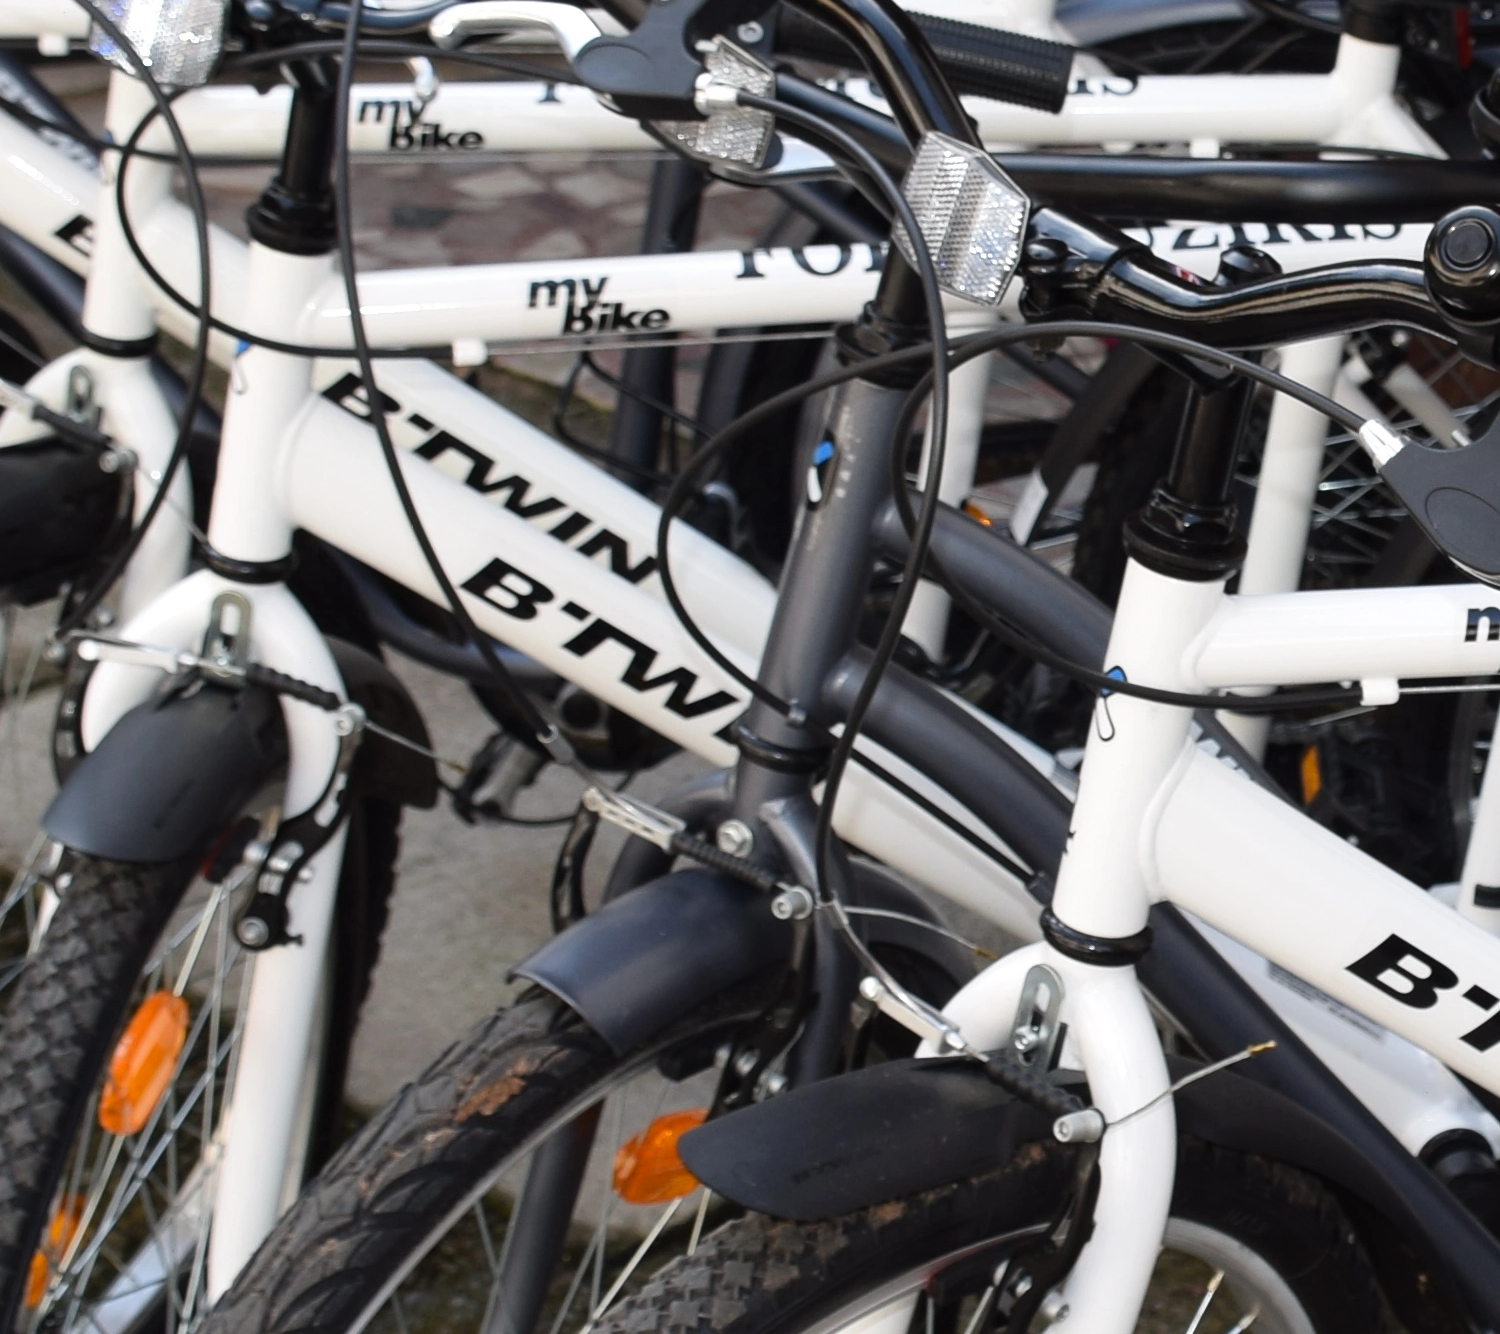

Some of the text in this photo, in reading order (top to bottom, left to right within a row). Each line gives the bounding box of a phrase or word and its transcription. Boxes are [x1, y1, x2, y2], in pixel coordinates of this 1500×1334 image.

[359, 97, 430, 130] my
[528, 277, 609, 311] my
[459, 556, 744, 743] B'TW
